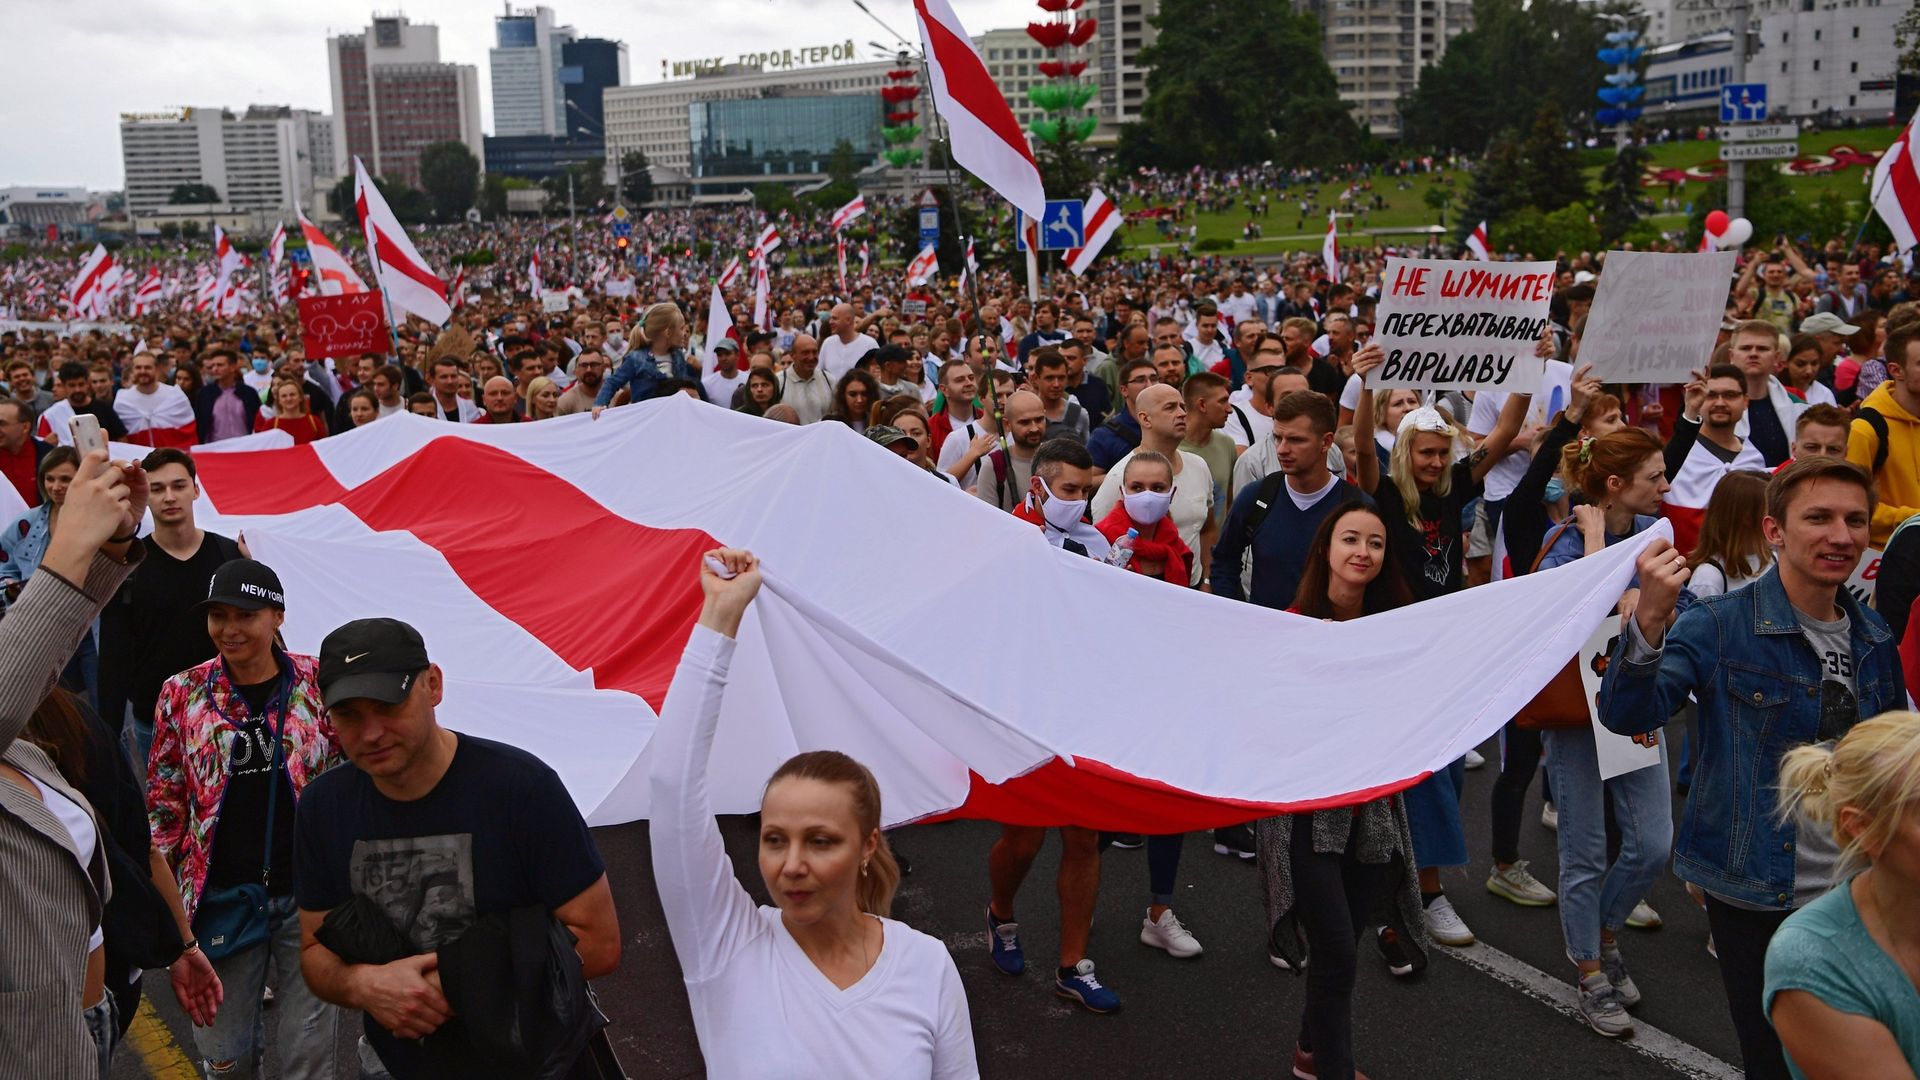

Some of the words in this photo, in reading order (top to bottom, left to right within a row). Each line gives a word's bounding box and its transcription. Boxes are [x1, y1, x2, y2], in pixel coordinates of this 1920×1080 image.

[739, 39, 855, 70] ГОРОД-ГЕРОЙ
[1391, 265, 1431, 297] НЕ
[1440, 268, 1556, 302] ШУМИТЕ!
[1382, 312, 1547, 341] ПЕРЕХВАТЫВАЮ
[1380, 349, 1515, 385] ВАРШАВУ
[241, 583, 266, 597] NEW
[267, 589, 284, 603] YORK
